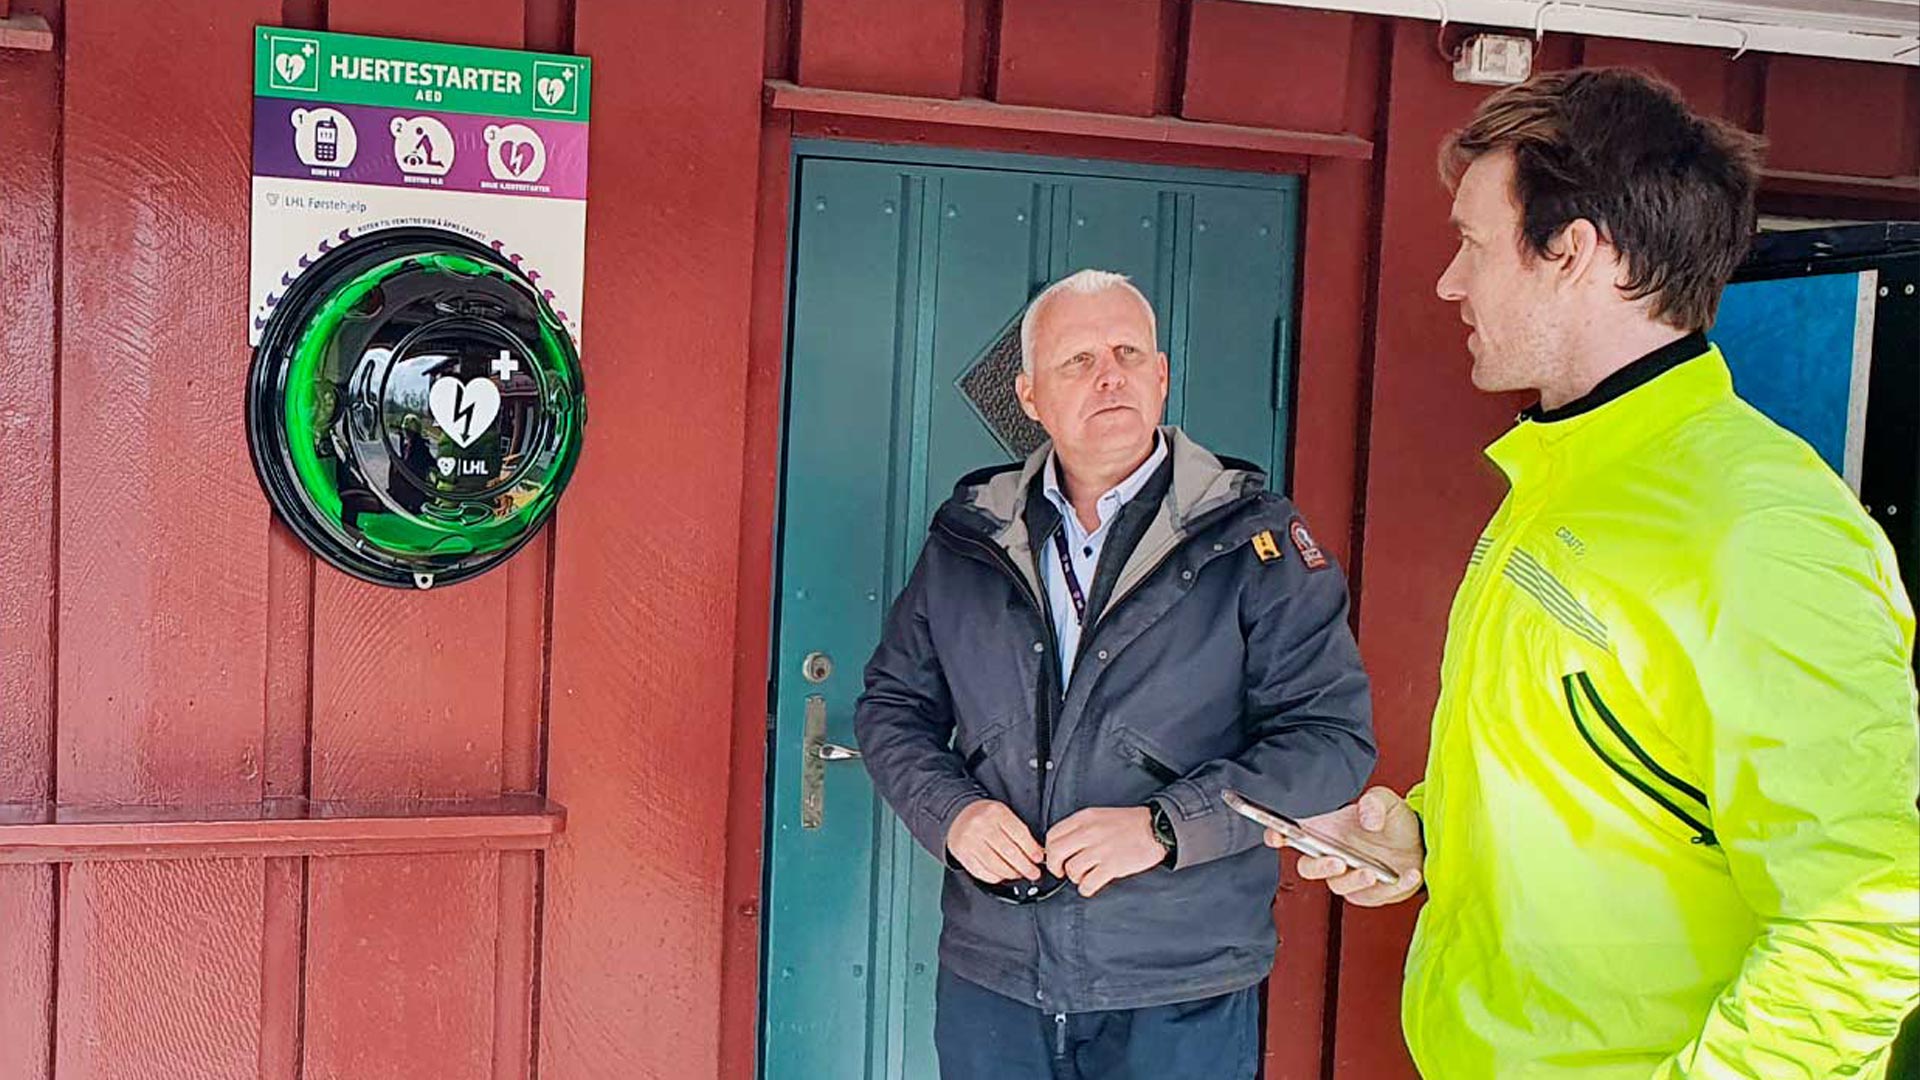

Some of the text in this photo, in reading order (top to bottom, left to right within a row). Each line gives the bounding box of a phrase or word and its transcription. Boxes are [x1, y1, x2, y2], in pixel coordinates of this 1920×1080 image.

[330, 55, 522, 95] HJERTESTARTER
[415, 90, 443, 102] AED
[298, 114, 303, 124] 1
[396, 122, 403, 132] 2
[285, 196, 367, 213] LHL Førstehjelp
[463, 459, 489, 475] LHL
